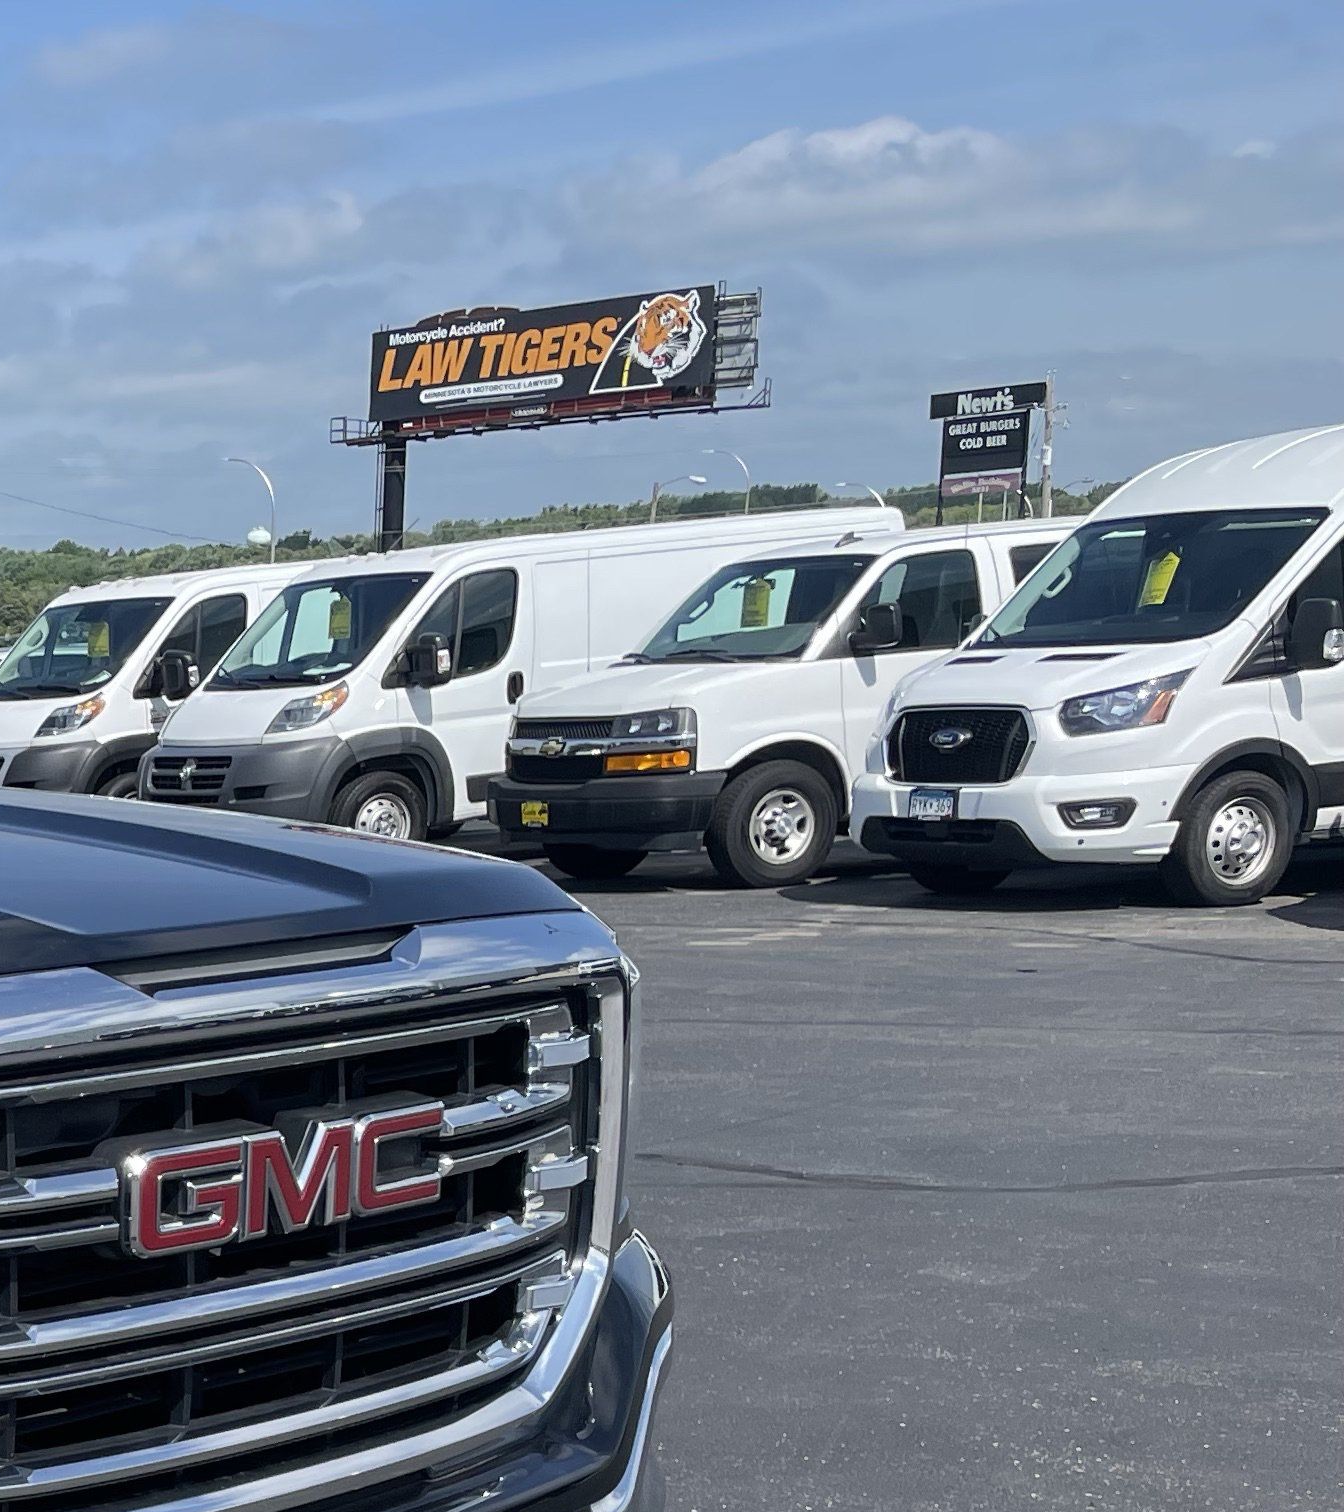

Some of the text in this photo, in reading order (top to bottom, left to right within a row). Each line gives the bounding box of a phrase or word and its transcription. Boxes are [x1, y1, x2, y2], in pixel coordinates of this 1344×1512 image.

[389, 318, 505, 346] Motorcycle Accident?
[377, 317, 619, 392] LAW TIGERS
[473, 383, 522, 394] MOTORCYCLE
[523, 377, 558, 389] LAWYERS
[957, 388, 1014, 415] Newt's
[948, 417, 1020, 436] GREAT BURGERS
[959, 434, 1007, 450] COLD BEER
[934, 798, 952, 813] 369
[122, 1100, 445, 1259] GMC
